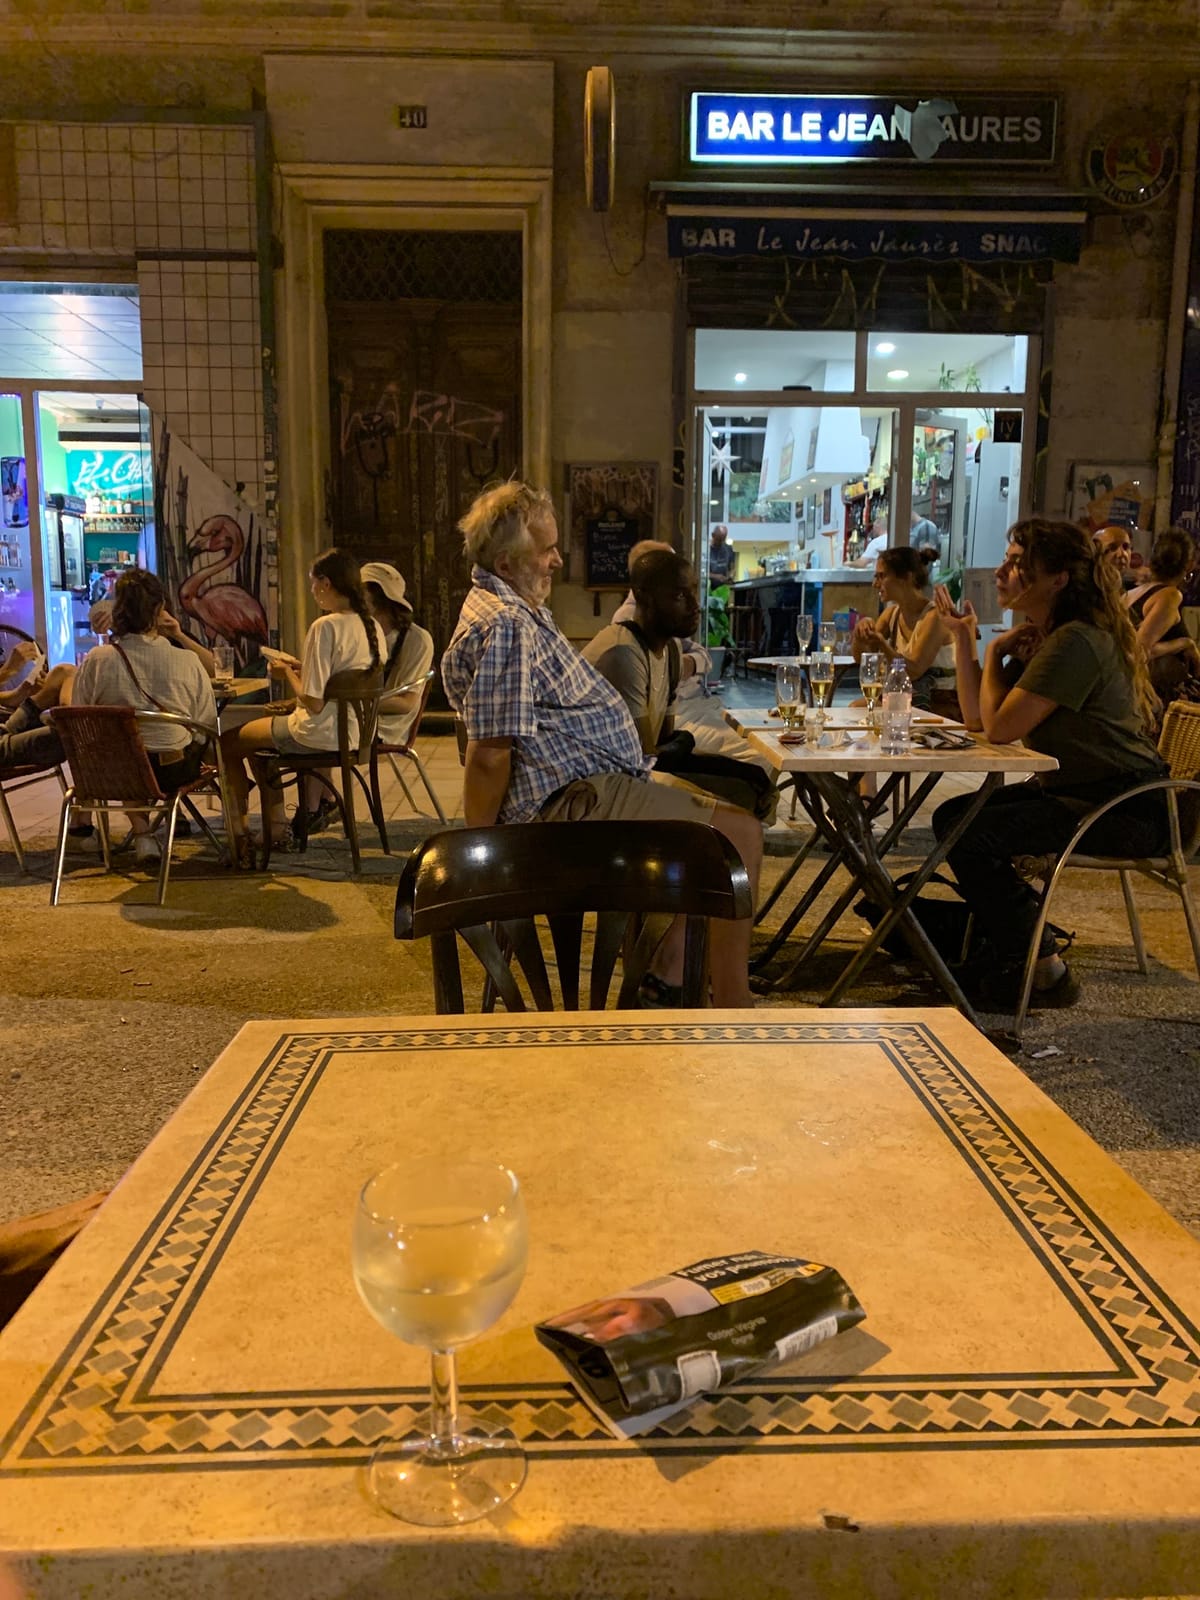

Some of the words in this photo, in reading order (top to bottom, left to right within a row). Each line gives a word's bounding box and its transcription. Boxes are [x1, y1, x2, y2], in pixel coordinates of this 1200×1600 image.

[401, 111, 425, 127] 40
[707, 111, 775, 140] BAR
[782, 112, 822, 141] LE
[829, 113, 912, 142] JEAN
[939, 114, 1042, 143] AURES
[682, 227, 736, 248] BAR
[757, 226, 783, 250] Le
[796, 228, 857, 251] Jean
[676, 1259, 728, 1277] Fumer
[694, 1268, 726, 1281] vos
